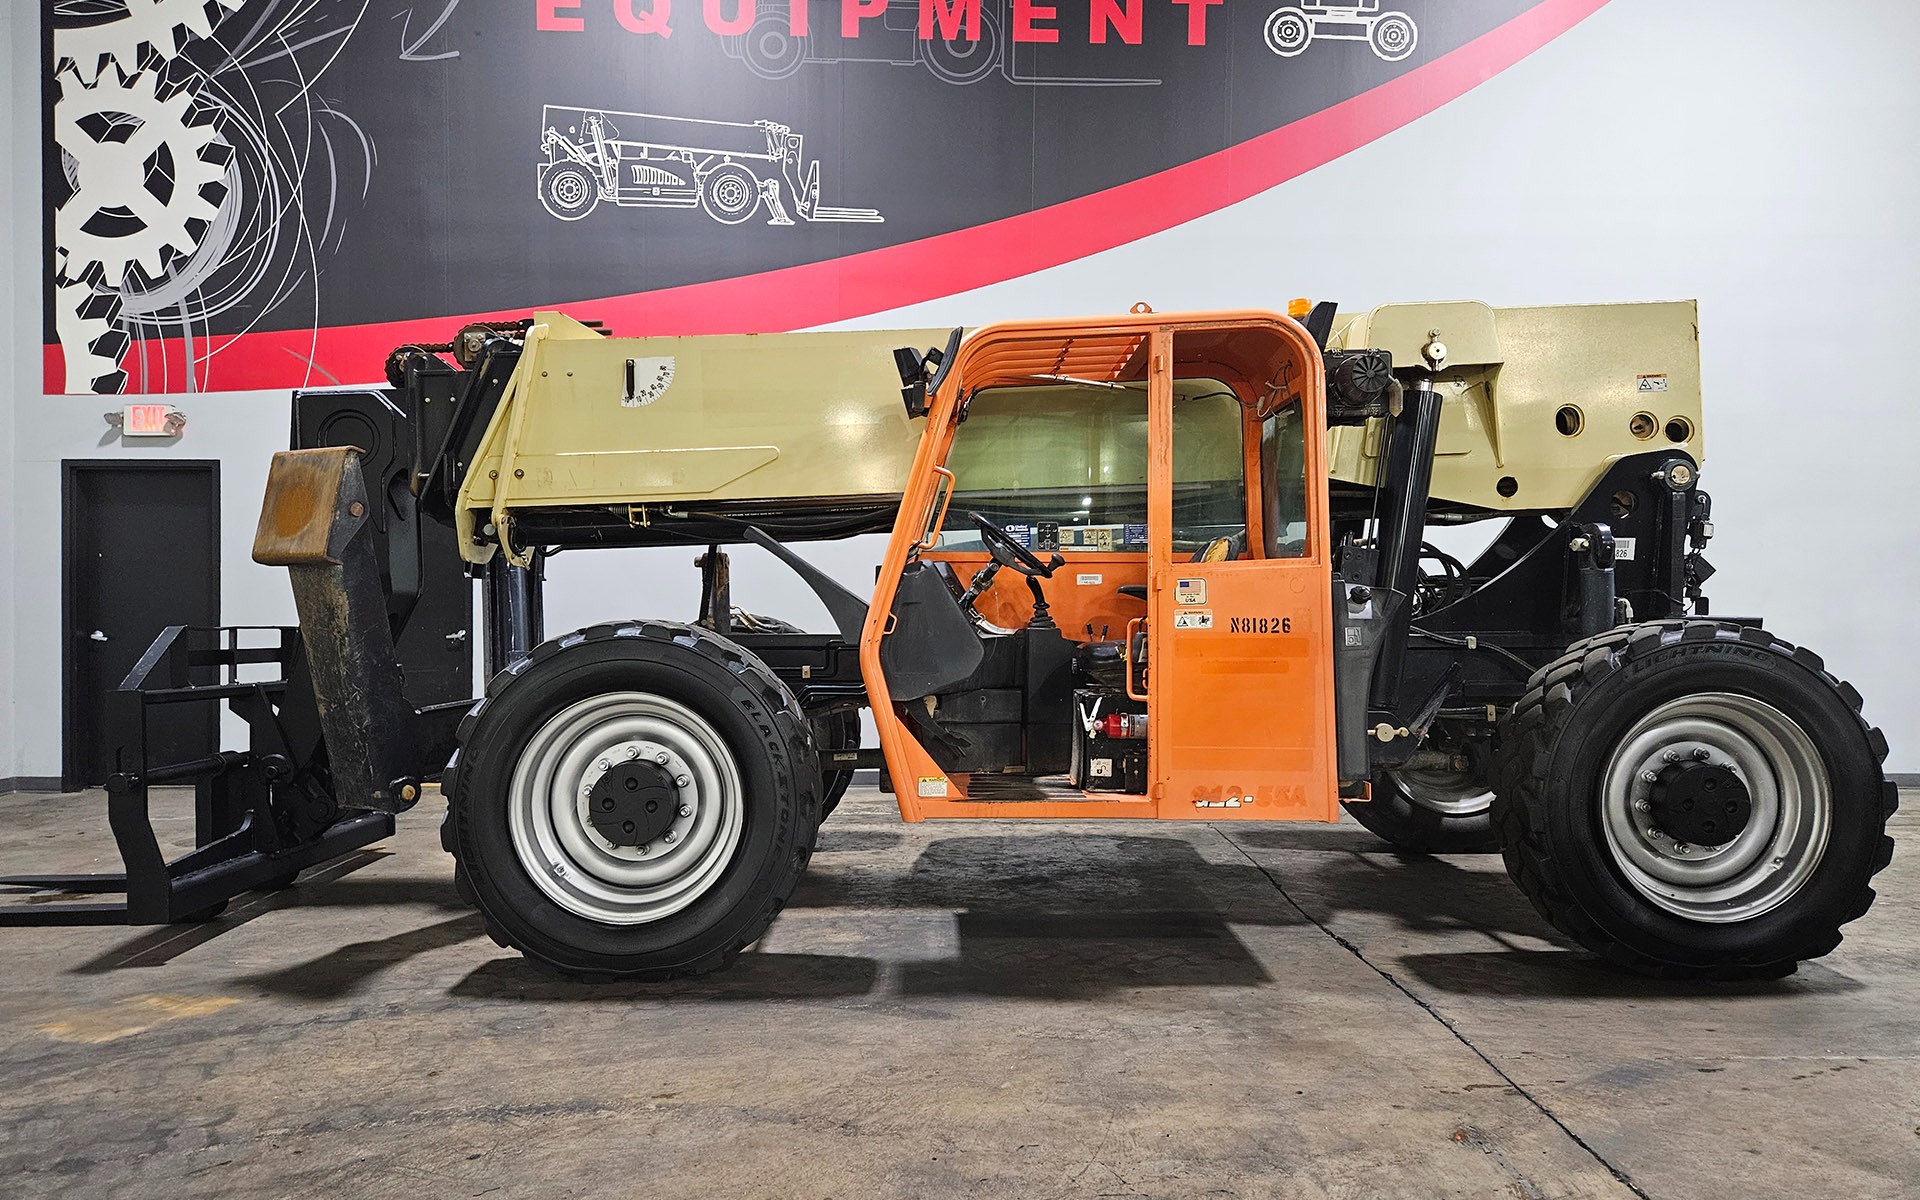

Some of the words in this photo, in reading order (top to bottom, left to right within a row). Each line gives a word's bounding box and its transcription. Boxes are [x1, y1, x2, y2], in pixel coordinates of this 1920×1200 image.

[536, 0, 1224, 45] EQUIPMENT
[132, 406, 165, 431] EXIT
[1615, 549, 1628, 558] 826
[1231, 617, 1291, 634] N81826
[1633, 643, 1771, 673] LIGHTNING
